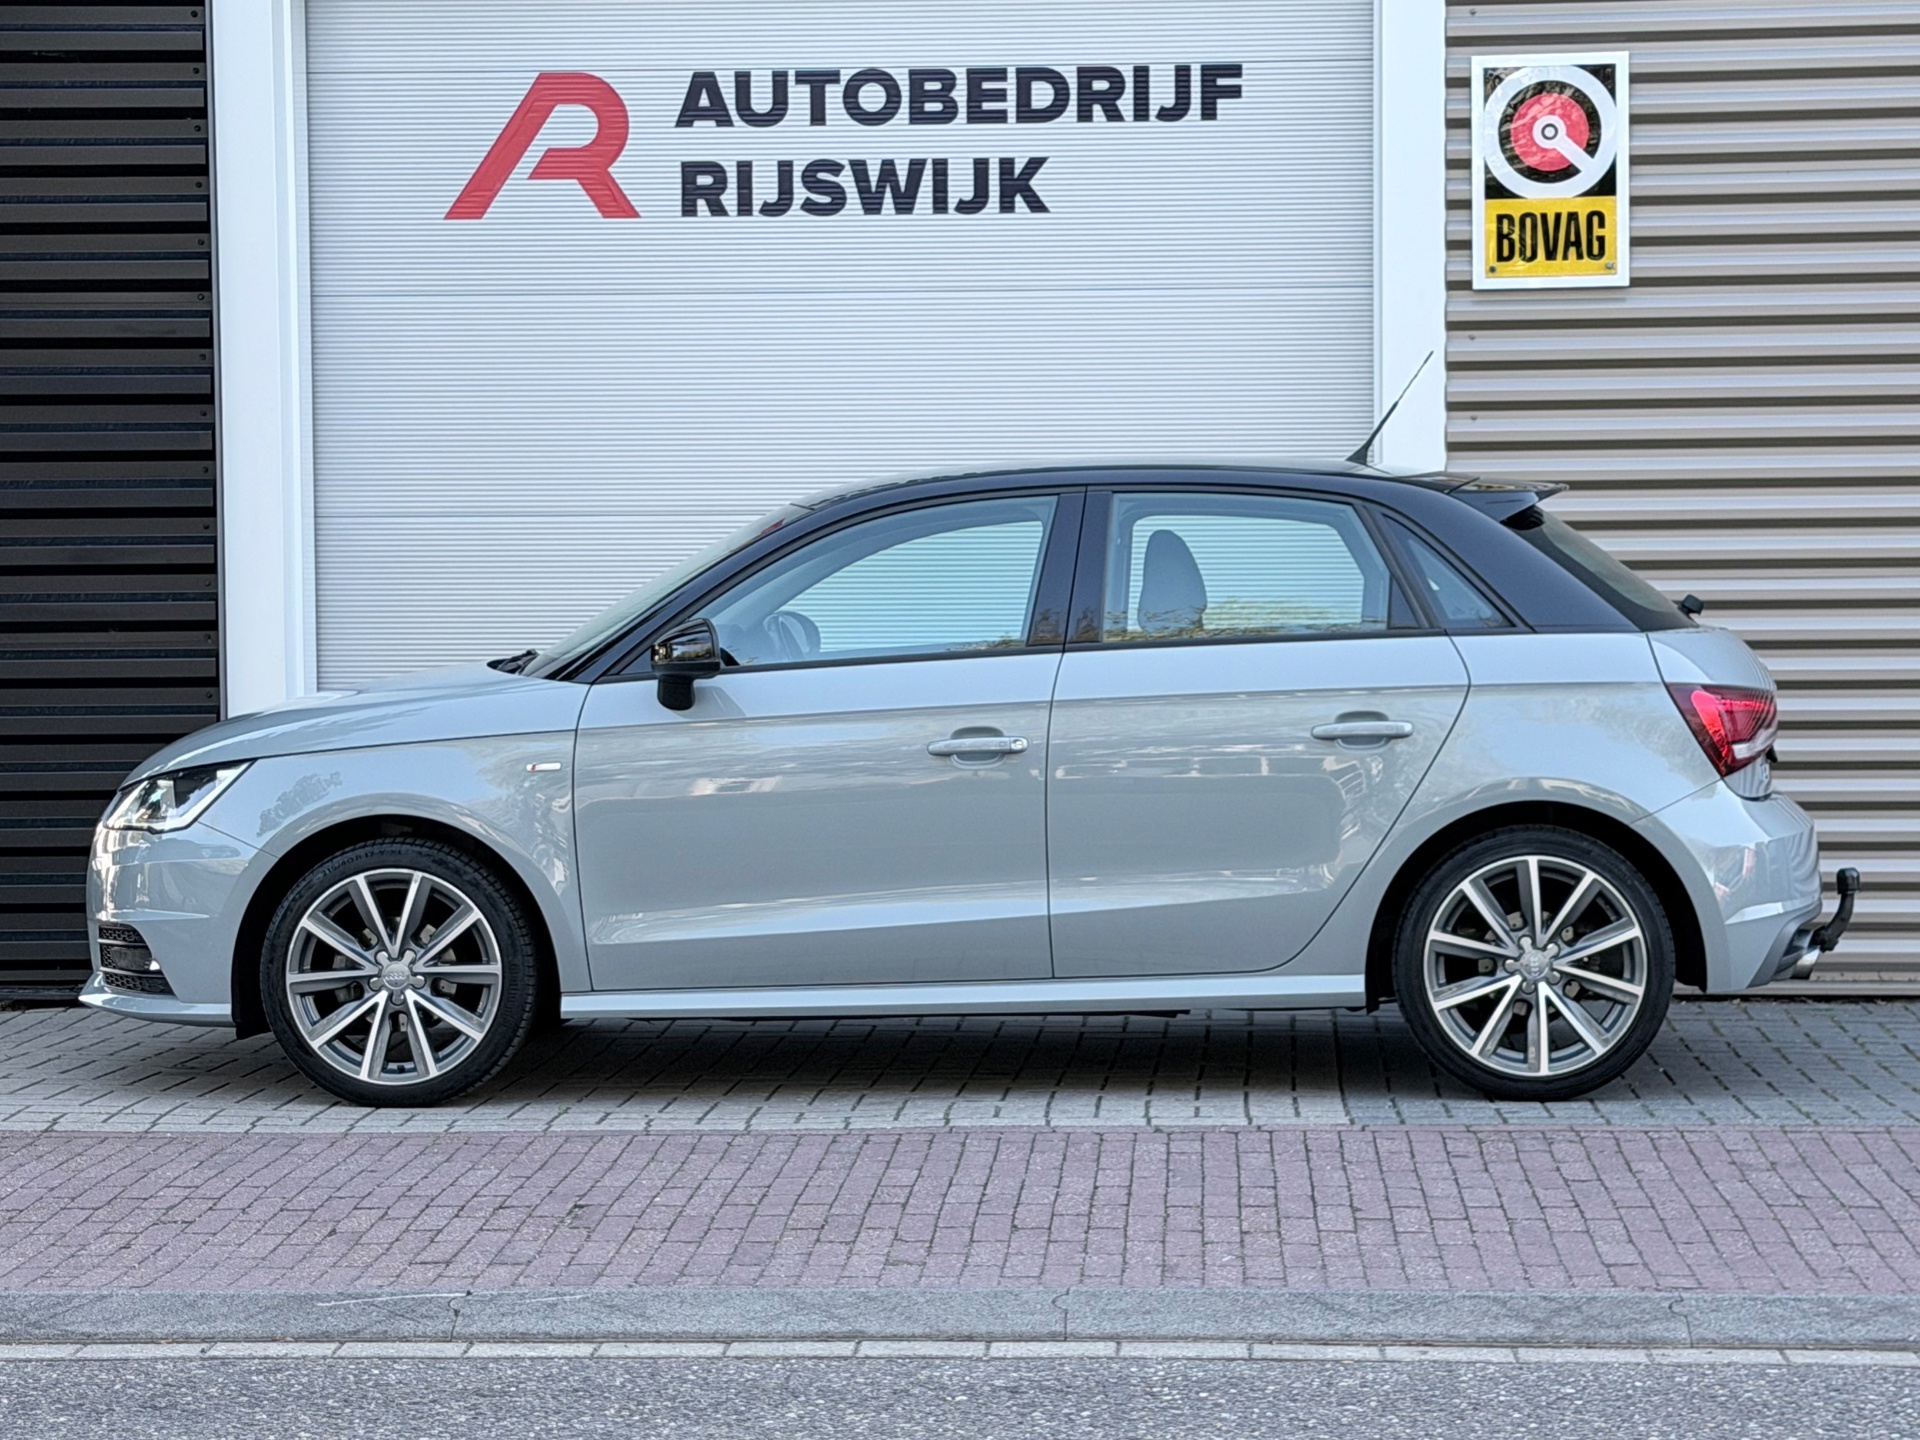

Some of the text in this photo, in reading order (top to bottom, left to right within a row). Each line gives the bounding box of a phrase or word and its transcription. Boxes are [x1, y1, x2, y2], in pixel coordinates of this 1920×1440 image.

[674, 64, 1243, 128] AUTOBEDRIJF
[680, 157, 1050, 217] RIJSWIJK
[1496, 210, 1606, 263] BOVAG
